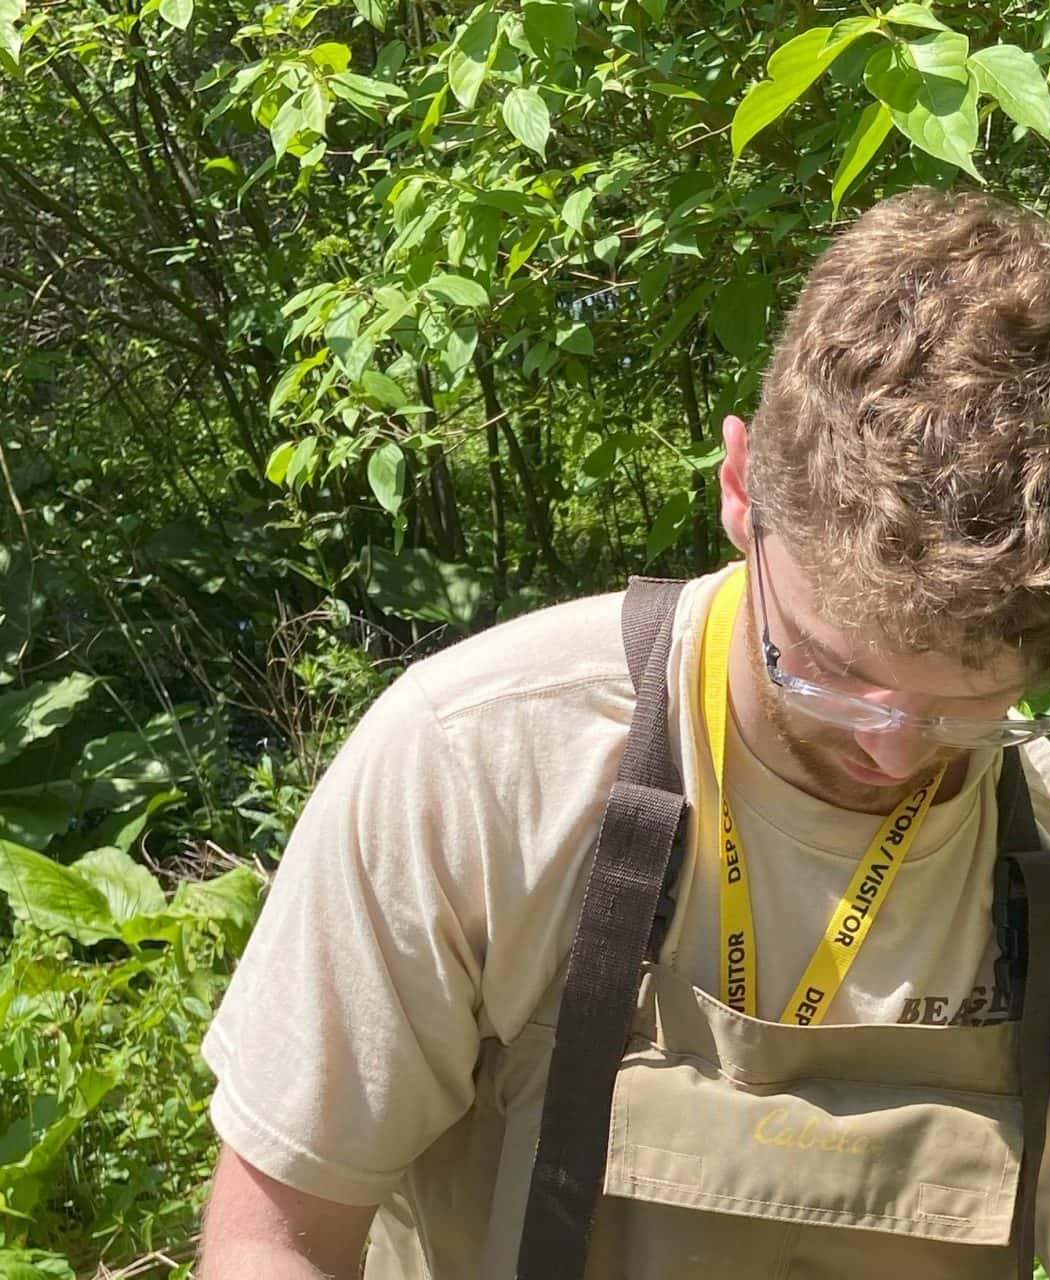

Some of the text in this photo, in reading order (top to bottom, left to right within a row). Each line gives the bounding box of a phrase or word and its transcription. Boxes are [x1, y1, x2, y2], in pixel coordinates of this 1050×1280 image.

[725, 839, 741, 884] DEP
[834, 864, 890, 947] VISITOR
[728, 931, 745, 1013] VISITOR
[795, 986, 825, 1026] DEP
